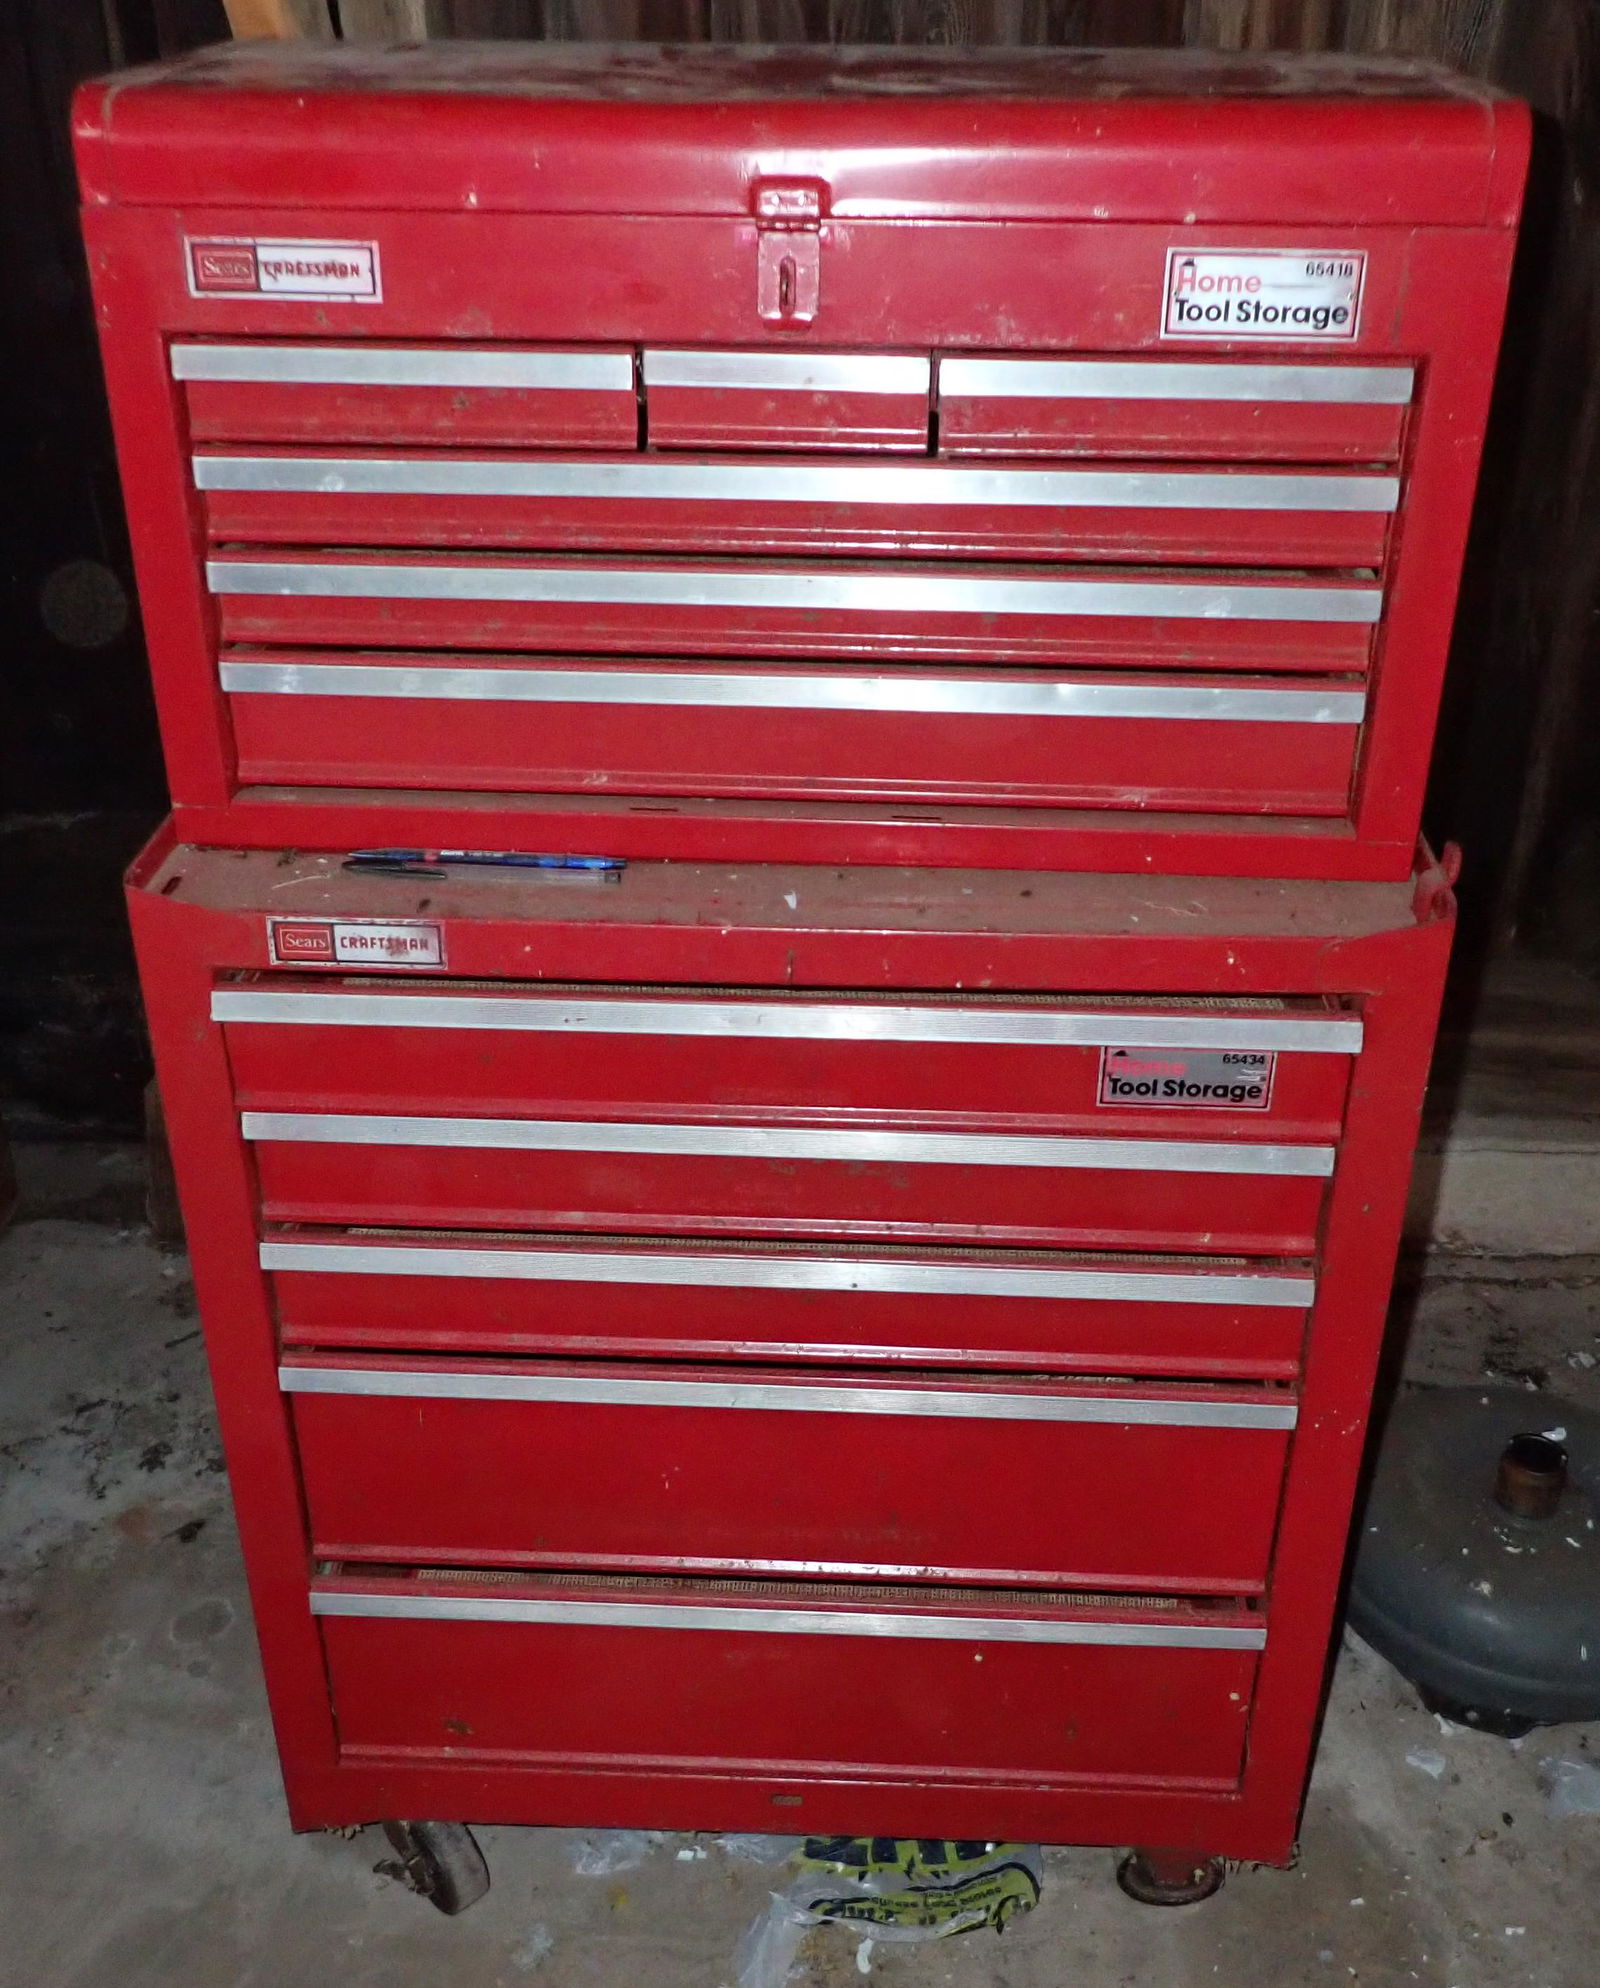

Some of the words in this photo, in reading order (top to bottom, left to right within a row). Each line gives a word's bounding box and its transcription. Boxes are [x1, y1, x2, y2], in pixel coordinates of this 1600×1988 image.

[1176, 264, 1262, 294] Home
[1175, 298, 1231, 322] Tool
[1236, 299, 1349, 331] Storage
[284, 933, 327, 950] Sears
[1222, 1053, 1266, 1066] 65434
[1110, 1077, 1158, 1097] Tool
[1163, 1078, 1263, 1103] Storage
